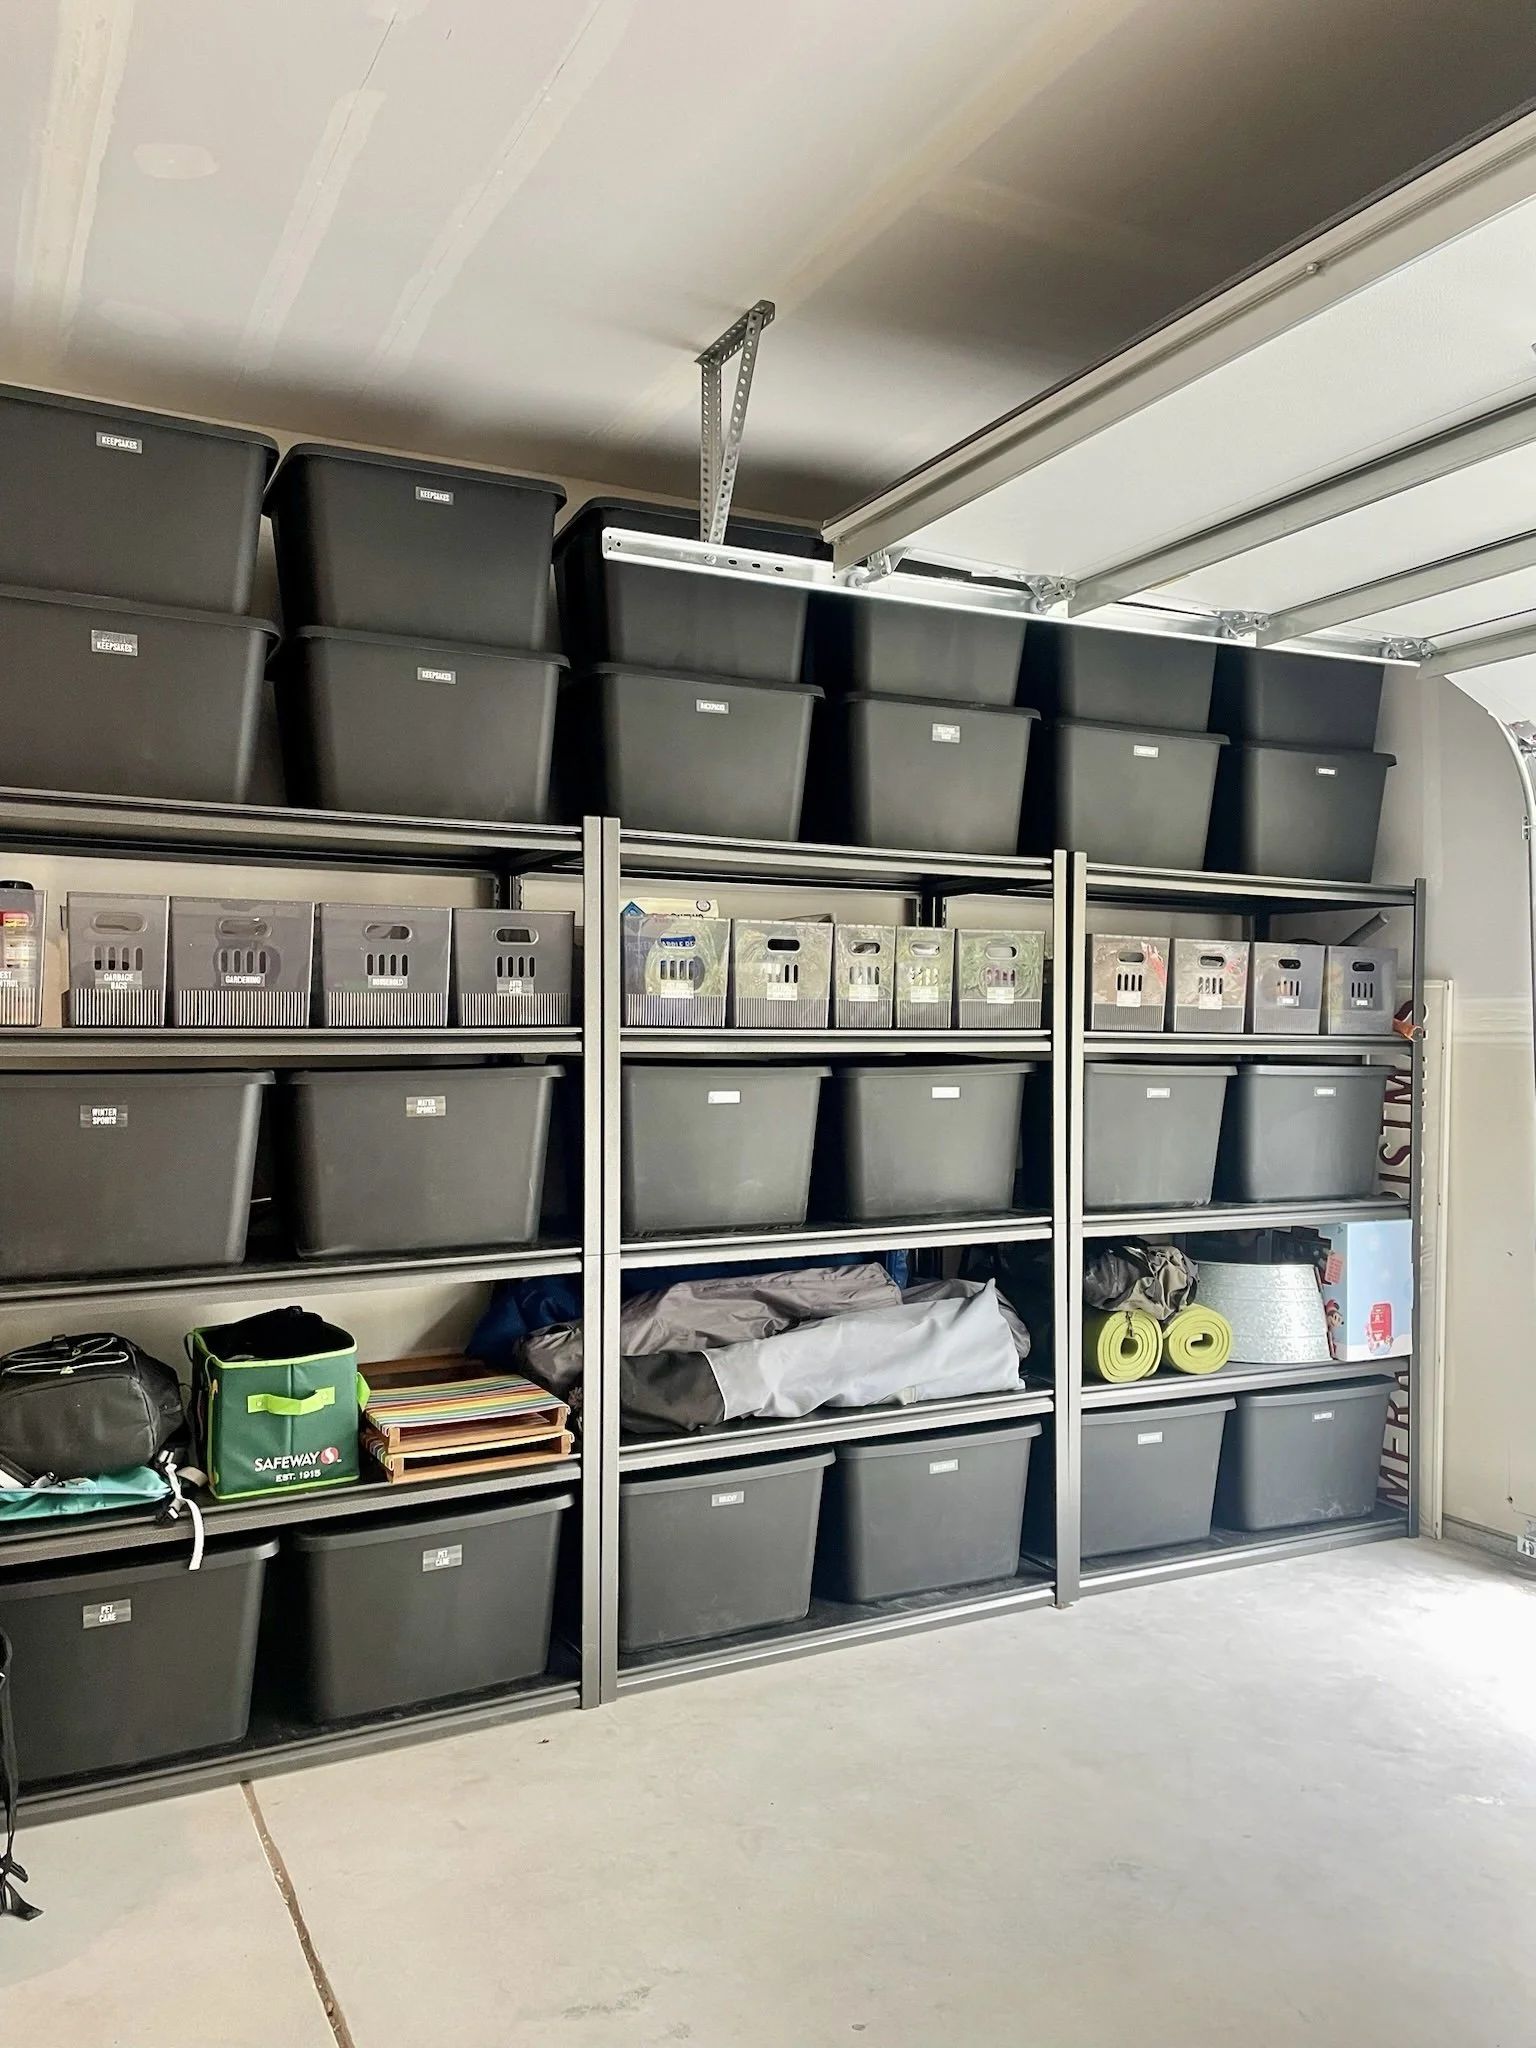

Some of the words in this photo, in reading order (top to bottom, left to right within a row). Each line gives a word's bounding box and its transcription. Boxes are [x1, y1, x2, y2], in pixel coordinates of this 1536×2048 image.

[101, 436, 138, 450] KEEPSAKES
[420, 490, 451, 502] KEEPSAKES
[96, 641, 133, 653] KEEPSAKES
[422, 670, 452, 681] KEEPSAKES
[0, 971, 12, 979] EST
[103, 973, 134, 982] GARBAGE
[0, 980, 19, 988] NTROL
[92, 1108, 117, 1117] WINTER
[92, 1117, 117, 1125] SPORTS
[254, 1451, 321, 1473] SAFEWAY
[275, 1472, 297, 1483] EST.
[299, 1468, 322, 1480] 1915
[101, 1604, 114, 1614] PET
[99, 1612, 117, 1623] CARE
